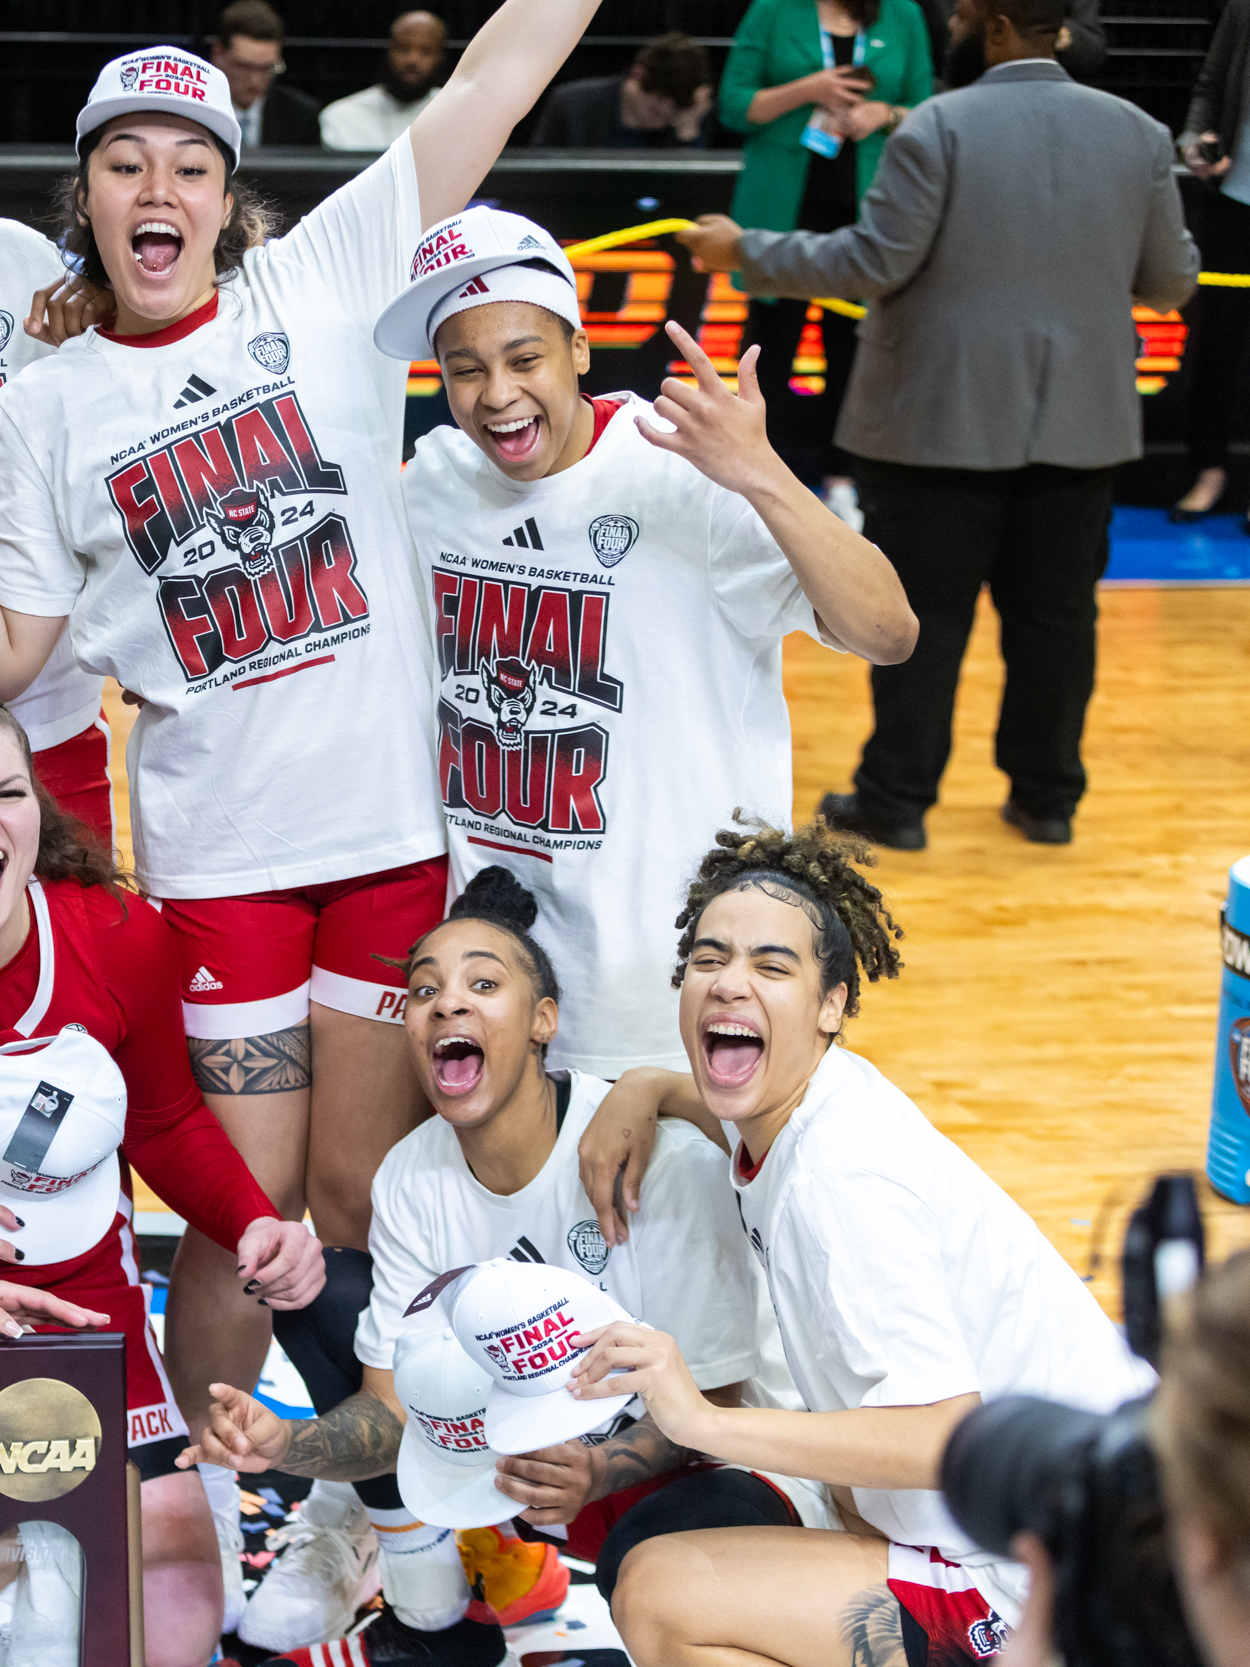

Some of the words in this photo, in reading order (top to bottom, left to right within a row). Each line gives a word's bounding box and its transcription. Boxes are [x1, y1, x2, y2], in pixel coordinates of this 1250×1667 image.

[141, 61, 208, 85] FINAL
[164, 74, 184, 82] 2024
[173, 56, 211, 75] BASKETBALL
[139, 78, 207, 103] FOUR
[425, 219, 463, 244] BASKETBALL
[413, 228, 463, 276] FINAL
[517, 242, 547, 251] adidas
[110, 441, 146, 466] NCAA
[149, 412, 210, 445] WOMEN'S
[212, 375, 296, 418] BASKETBALL
[104, 390, 348, 577] FINAL
[228, 508, 239, 518] NC
[238, 505, 256, 518] STATE
[183, 540, 216, 567] 20
[281, 500, 315, 526] 24
[598, 537, 625, 551] FOUR
[600, 526, 628, 538] FINAL
[440, 551, 467, 566] NCAA
[471, 558, 526, 575] WOMEN'S
[528, 567, 616, 586] BASKETBALL
[156, 512, 370, 682] FOUR
[431, 565, 624, 714] FINAL
[186, 666, 246, 695] PORTLAND
[249, 646, 302, 671] REGIONAL
[305, 623, 370, 654] CHAMPIONS
[499, 672, 508, 684] NC
[507, 674, 524, 689] STATE
[455, 684, 480, 704] 20
[539, 700, 578, 719] 24
[436, 695, 610, 835] FOUR
[483, 823, 530, 843] REGIONAL
[532, 835, 603, 850] CHAMPIONS
[189, 980, 224, 992] adidas
[375, 990, 407, 1020] PA
[494, 1322, 526, 1339] WOMEN'S
[527, 1297, 569, 1326] BASKETBALL
[499, 1311, 575, 1353] FINAL
[531, 1337, 554, 1352] 2024
[128, 1408, 174, 1442] ACK
[430, 1418, 484, 1434] FINA
[438, 1434, 488, 1449] FOU
